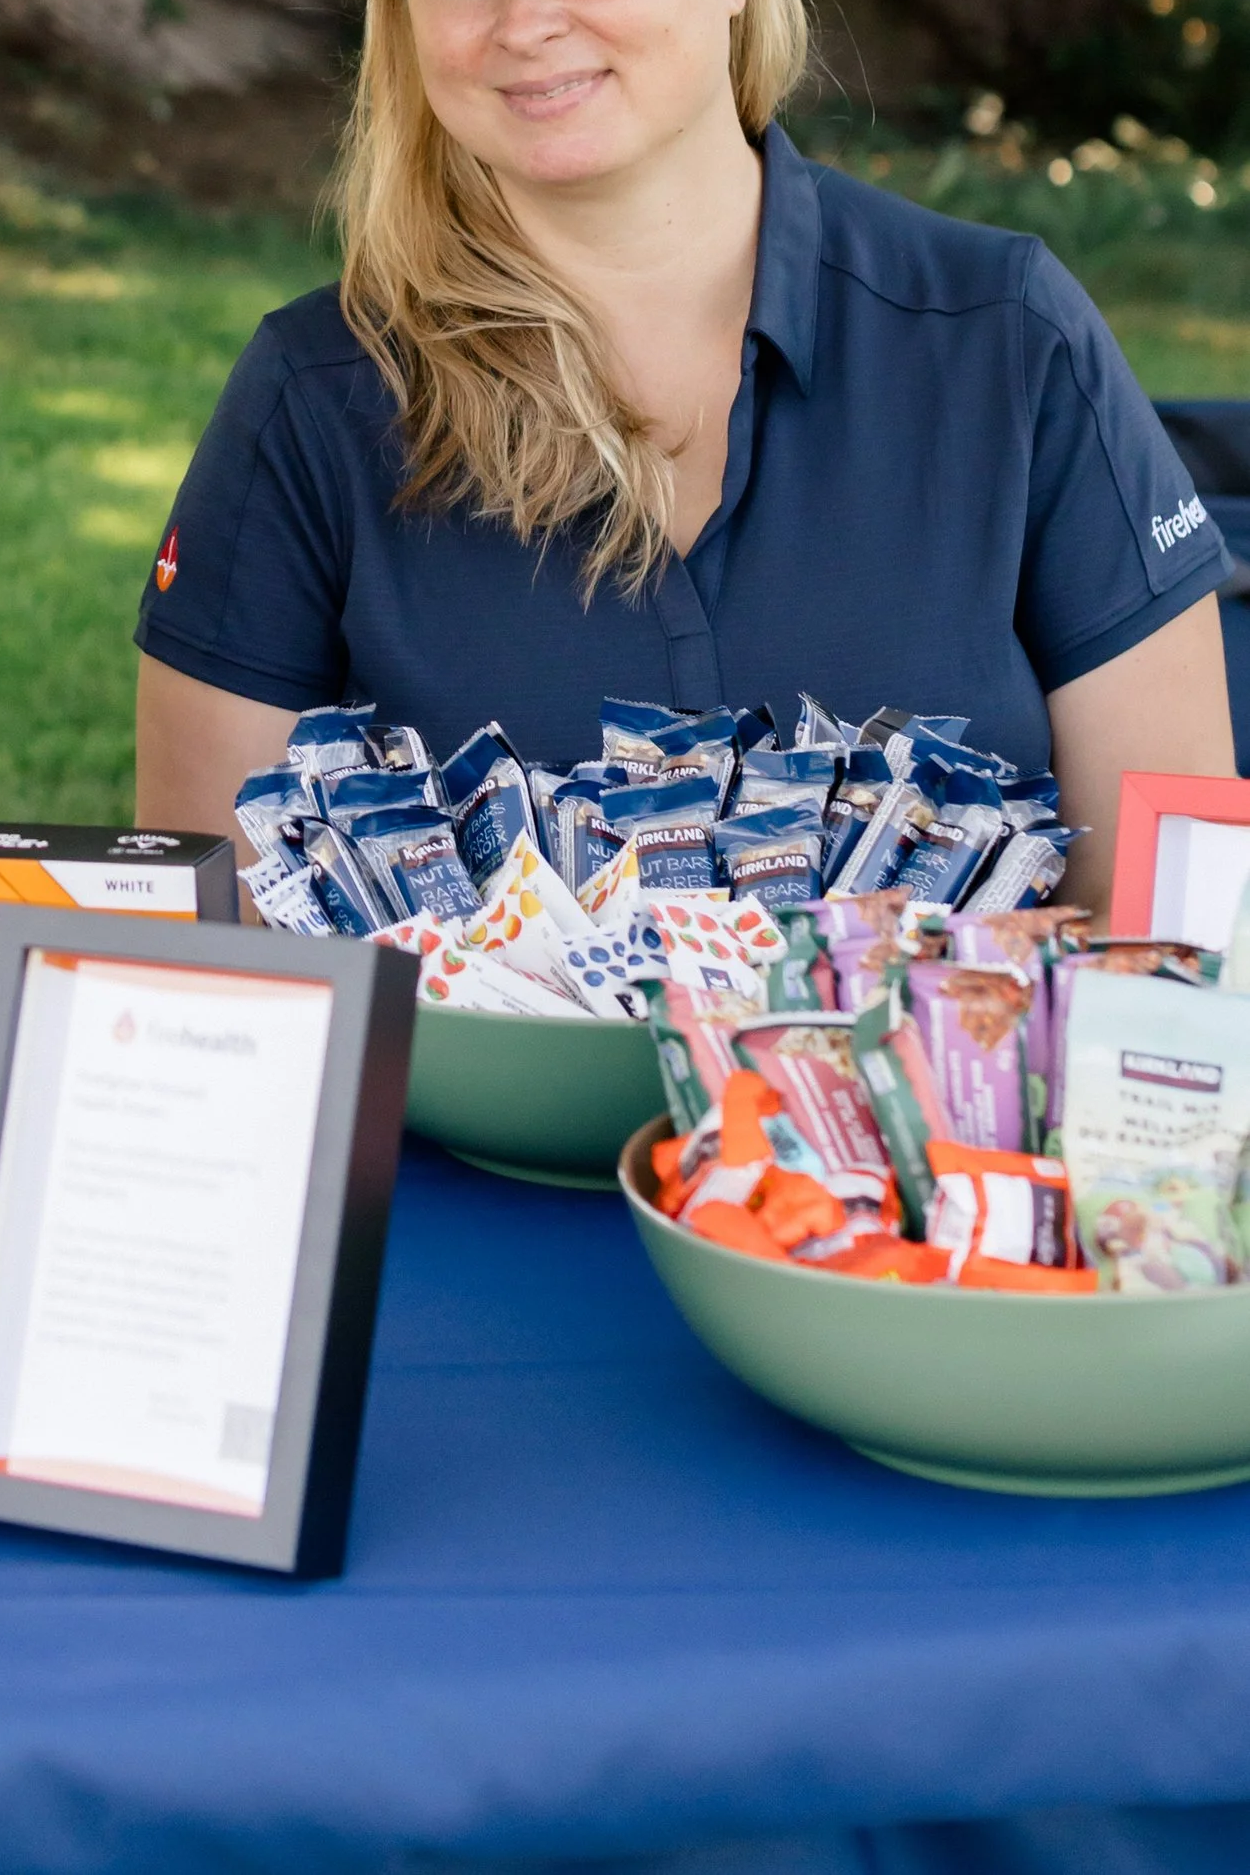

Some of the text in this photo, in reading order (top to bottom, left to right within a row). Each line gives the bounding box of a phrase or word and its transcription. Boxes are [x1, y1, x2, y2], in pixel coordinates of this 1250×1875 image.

[324, 764, 372, 781] KIRKLAN
[635, 827, 706, 848] IRKLAND
[640, 855, 713, 877] UT BARS
[733, 855, 809, 880] KIRKLAND
[105, 879, 155, 894] WHITE
[409, 865, 444, 889] NUT
[649, 874, 713, 888] ARRES
[764, 882, 811, 900] BARS
[430, 894, 483, 917] DE NO
